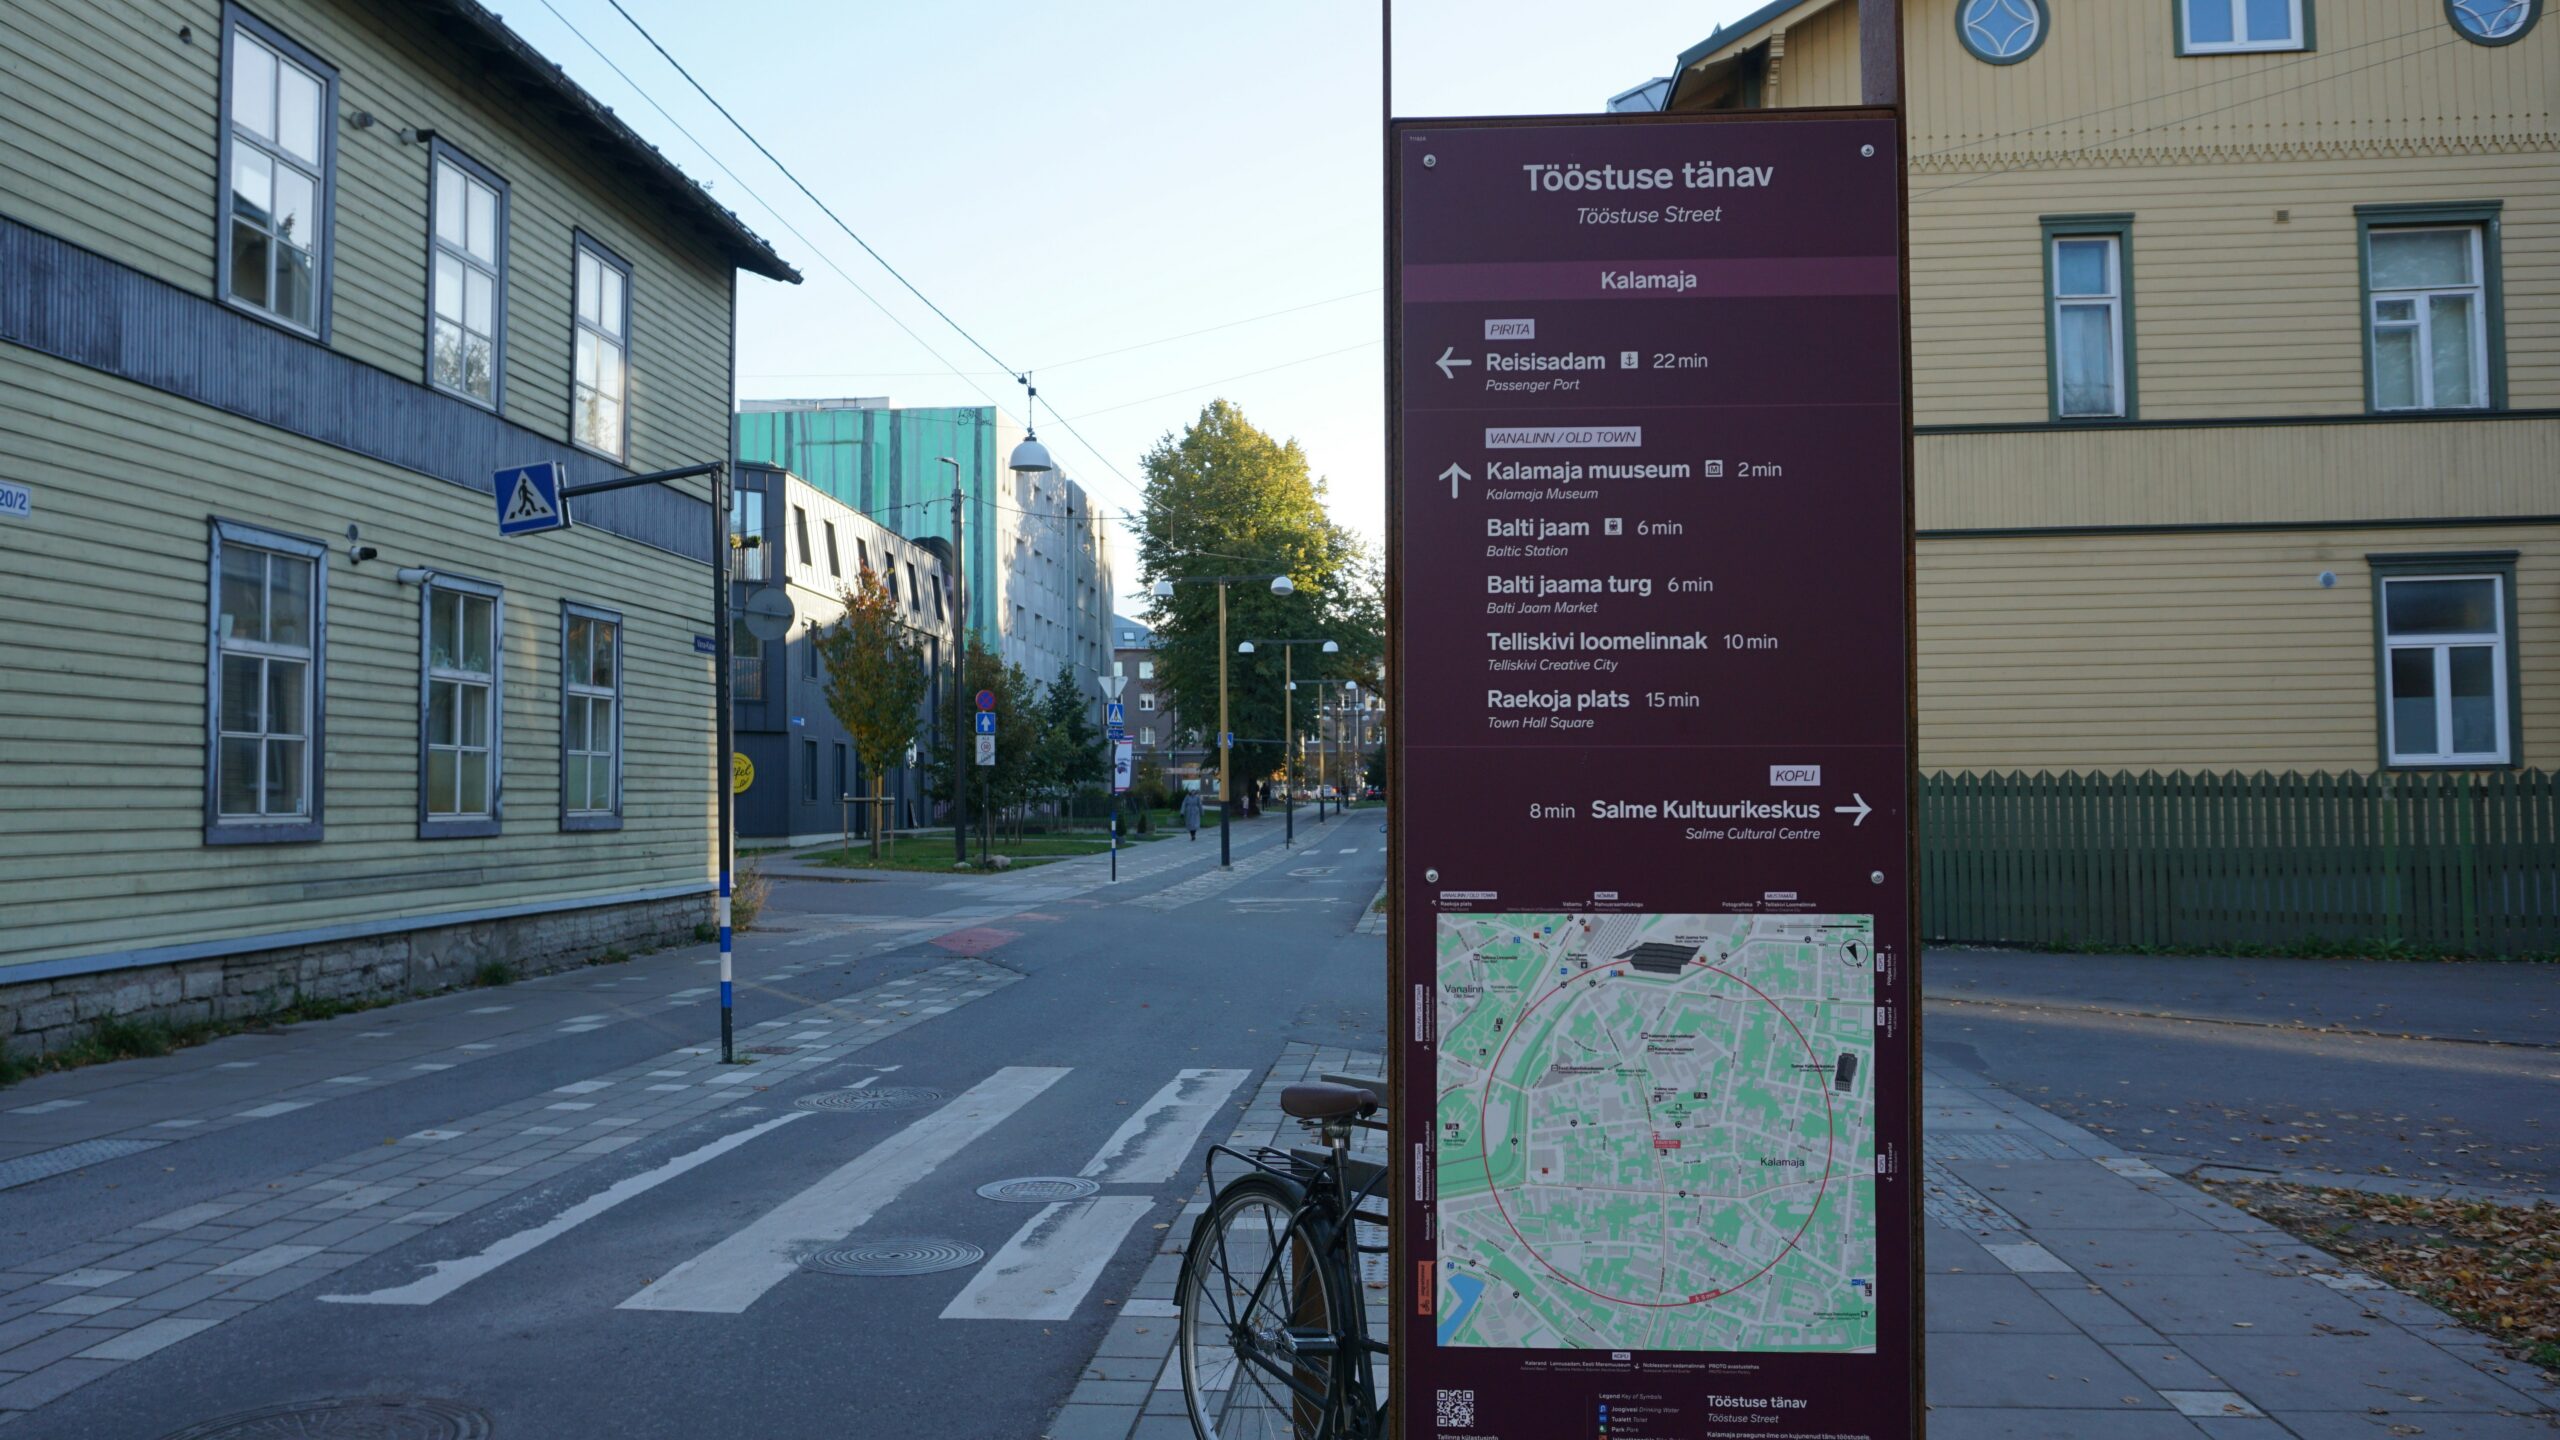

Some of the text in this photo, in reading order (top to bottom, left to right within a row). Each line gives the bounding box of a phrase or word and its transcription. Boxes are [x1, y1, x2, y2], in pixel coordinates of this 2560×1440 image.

[1523, 161, 1773, 191] Tööstuse tänav
[1578, 206, 1722, 224] Tööstuse Street
[1602, 270, 1696, 292] Kalamaja
[1490, 324, 1529, 335] PIRITA
[1487, 352, 1707, 371] Reisisadam 22 min
[1486, 379, 1580, 393] Passenger Port
[1491, 432, 1636, 444] VANALINN / OLD TOWN
[1487, 461, 1782, 483] Kalamaja muuseum 2 min
[0, 489, 26, 510] 20/2
[1487, 488, 1598, 502] Kalamaja Museum
[1488, 518, 1682, 540] Balti jaam 6 min
[1487, 545, 1568, 556] Baltic Station
[1488, 575, 1713, 597] Balti jaama turg 6 min
[1487, 602, 1598, 613] Balti Jaam Market
[1487, 632, 1777, 650] Telliskivi loomelinnak 10 min
[1488, 659, 1618, 672] Telliskivi Creative City
[1488, 690, 1699, 712] Raekoja plats 15 min
[1489, 717, 1594, 730] Town Hall Square
[1776, 770, 1815, 781] KOPLI
[1530, 800, 1820, 818] 8 min Salme Kultuurikeskus
[1686, 828, 1820, 839] Salme Cultural Centre
[1445, 984, 1484, 993] Vanalinn
[1760, 1157, 1805, 1168] Kalamaja
[1707, 1395, 1807, 1409] Tööstuse tänav
[1708, 1413, 1779, 1424] Tööstuse Street
[1707, 1431, 1735, 1439] Kalamaja
